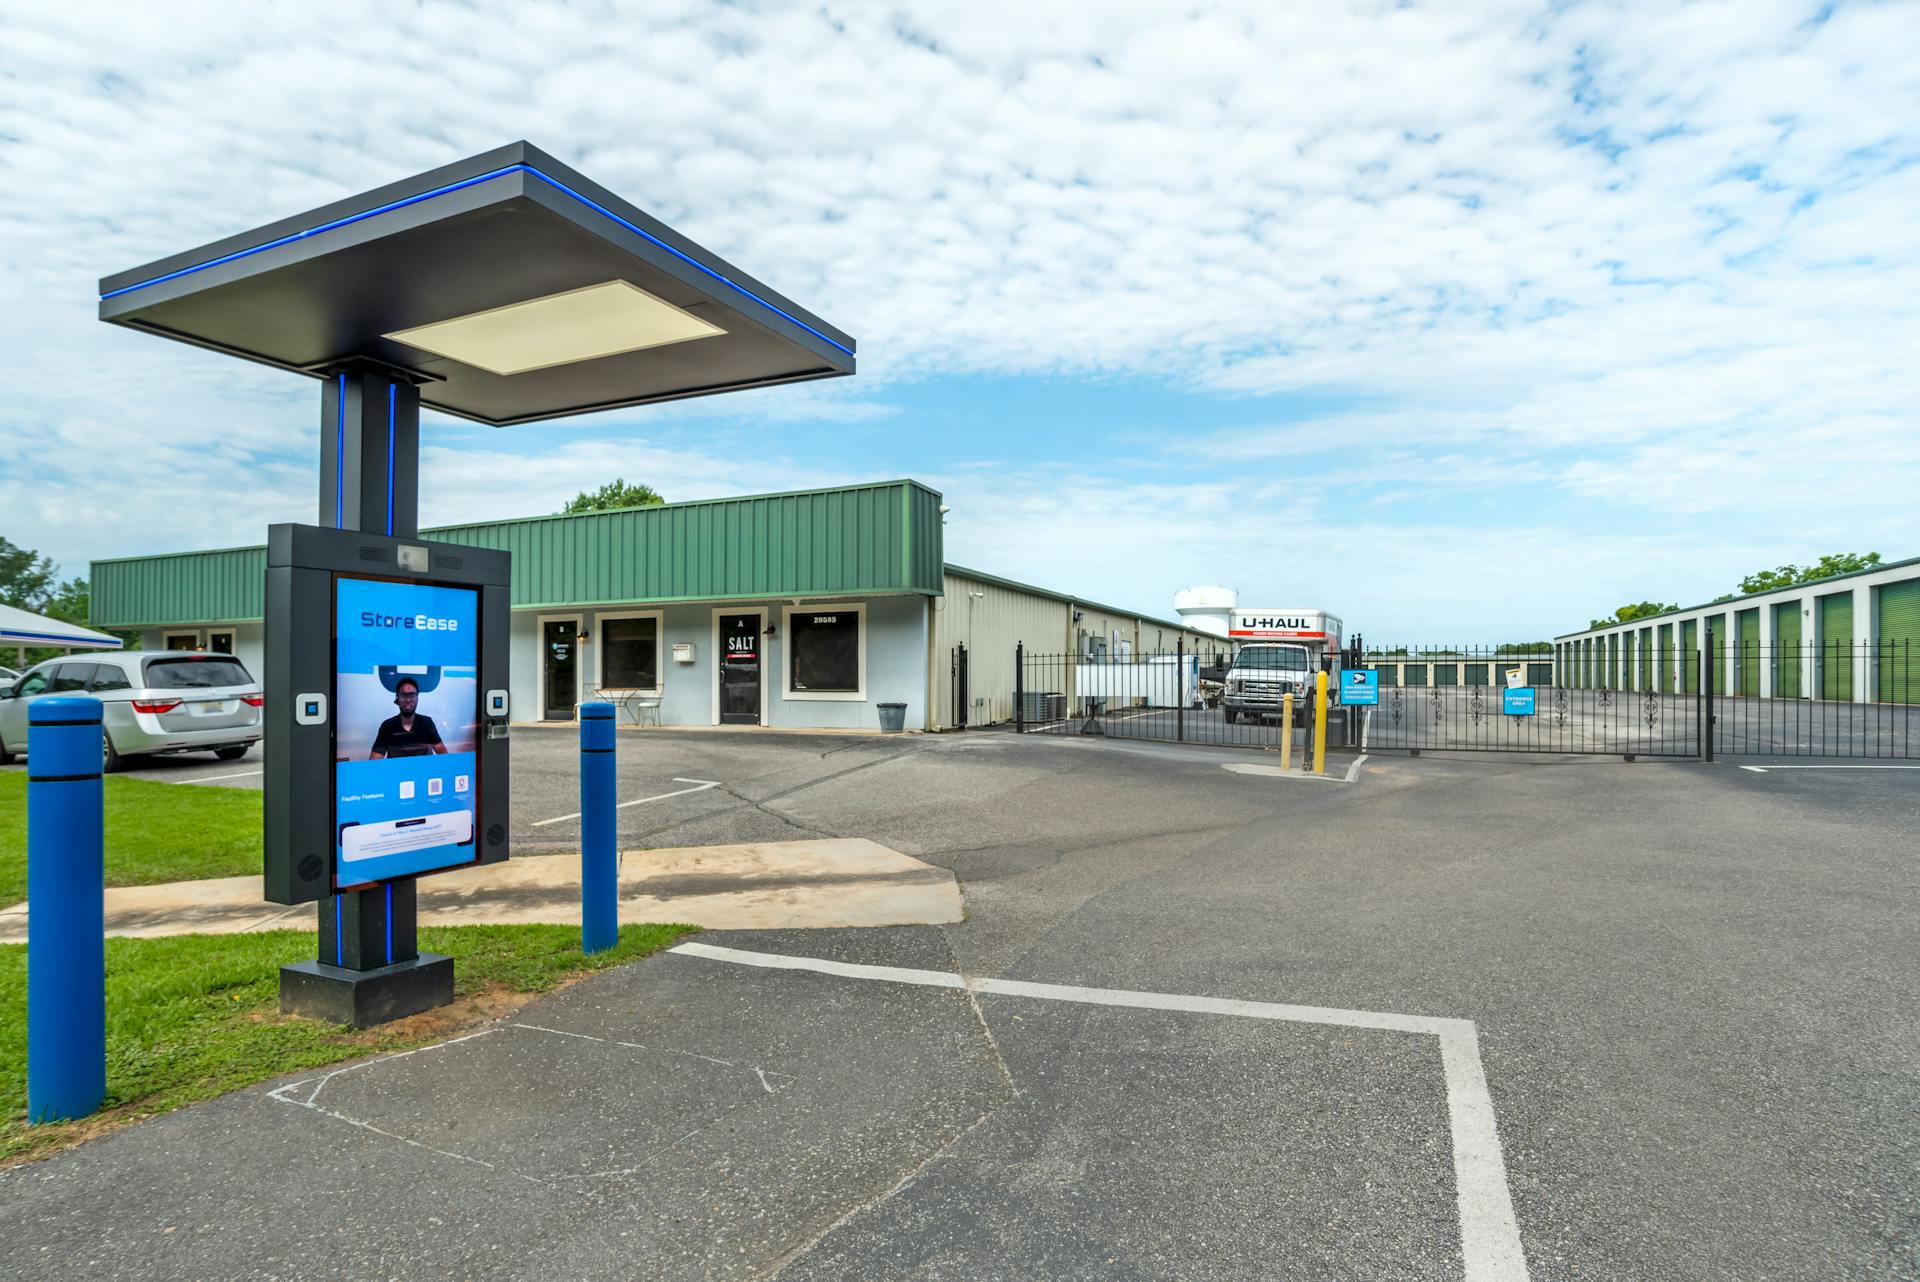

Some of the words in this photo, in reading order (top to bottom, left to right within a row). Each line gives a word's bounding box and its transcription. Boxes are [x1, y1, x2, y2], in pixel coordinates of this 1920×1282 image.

[361, 612, 458, 631] StoreEase
[813, 616, 837, 624] 20585
[1243, 618, 1310, 629] U-HAUL
[728, 636, 755, 650] SALT
